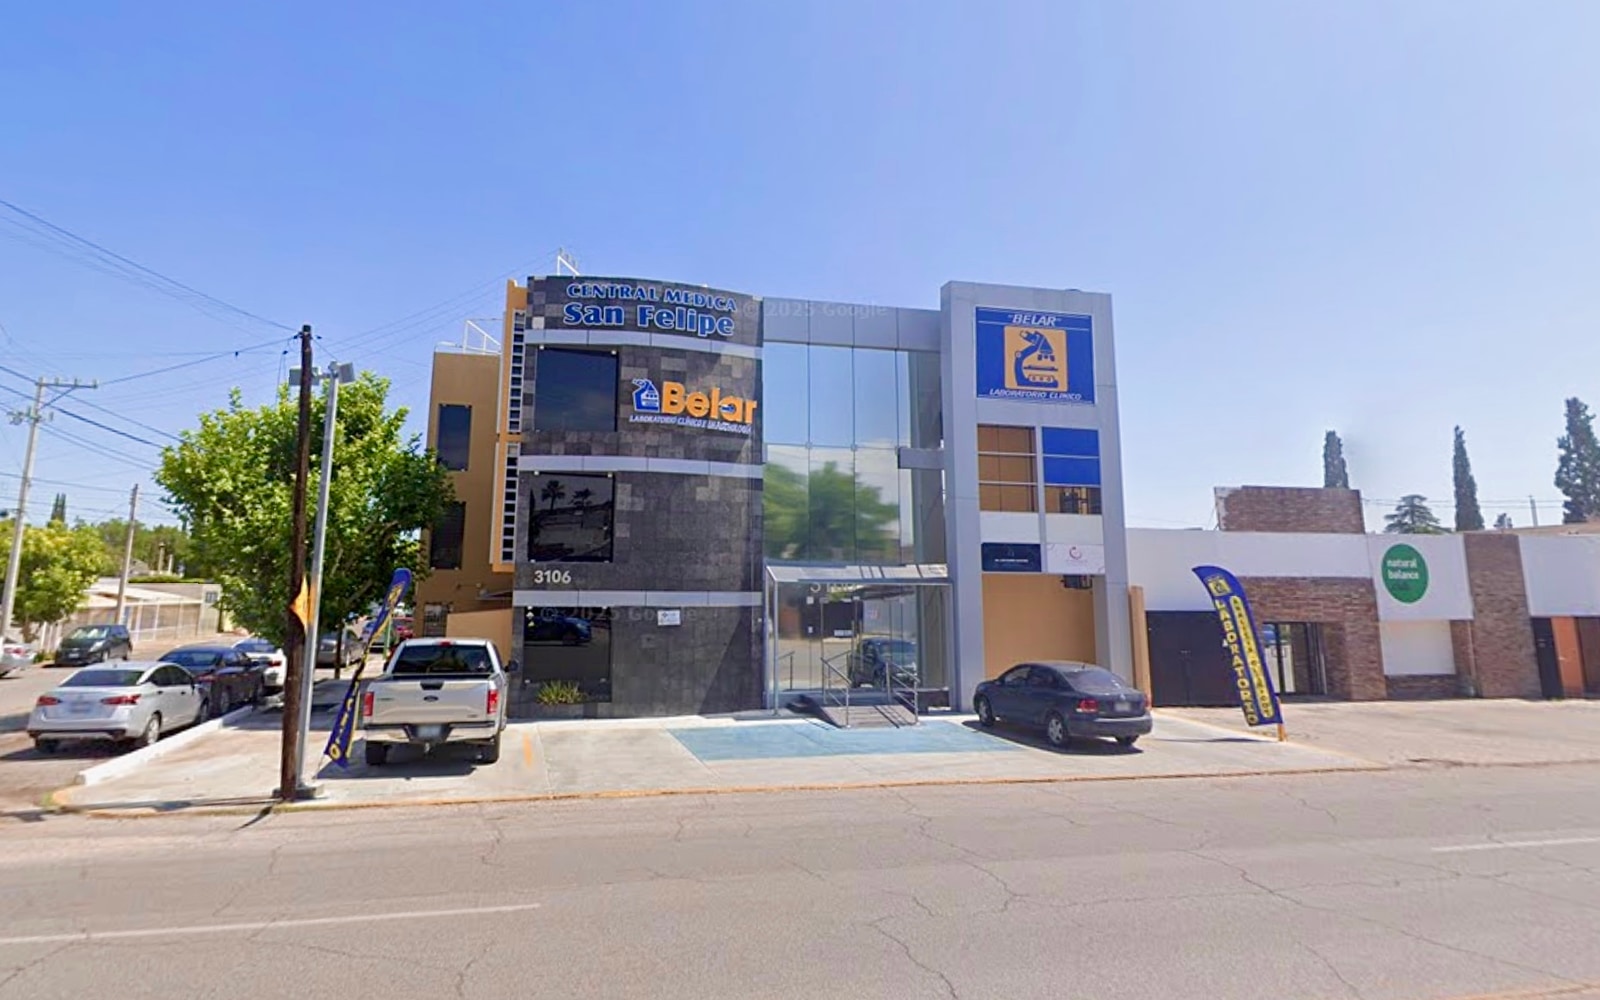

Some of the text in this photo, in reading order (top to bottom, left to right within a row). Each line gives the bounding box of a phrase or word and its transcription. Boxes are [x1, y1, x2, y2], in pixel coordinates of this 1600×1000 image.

[567, 283, 737, 312] CENTRAL MEDICA
[563, 302, 734, 337] San Felipe
[661, 381, 757, 424] Belar
[989, 388, 1047, 399] LABORATORIO
[629, 414, 677, 425] LABORATORIO
[534, 569, 572, 584] 3106
[1214, 598, 1259, 725] LABORATORIO
